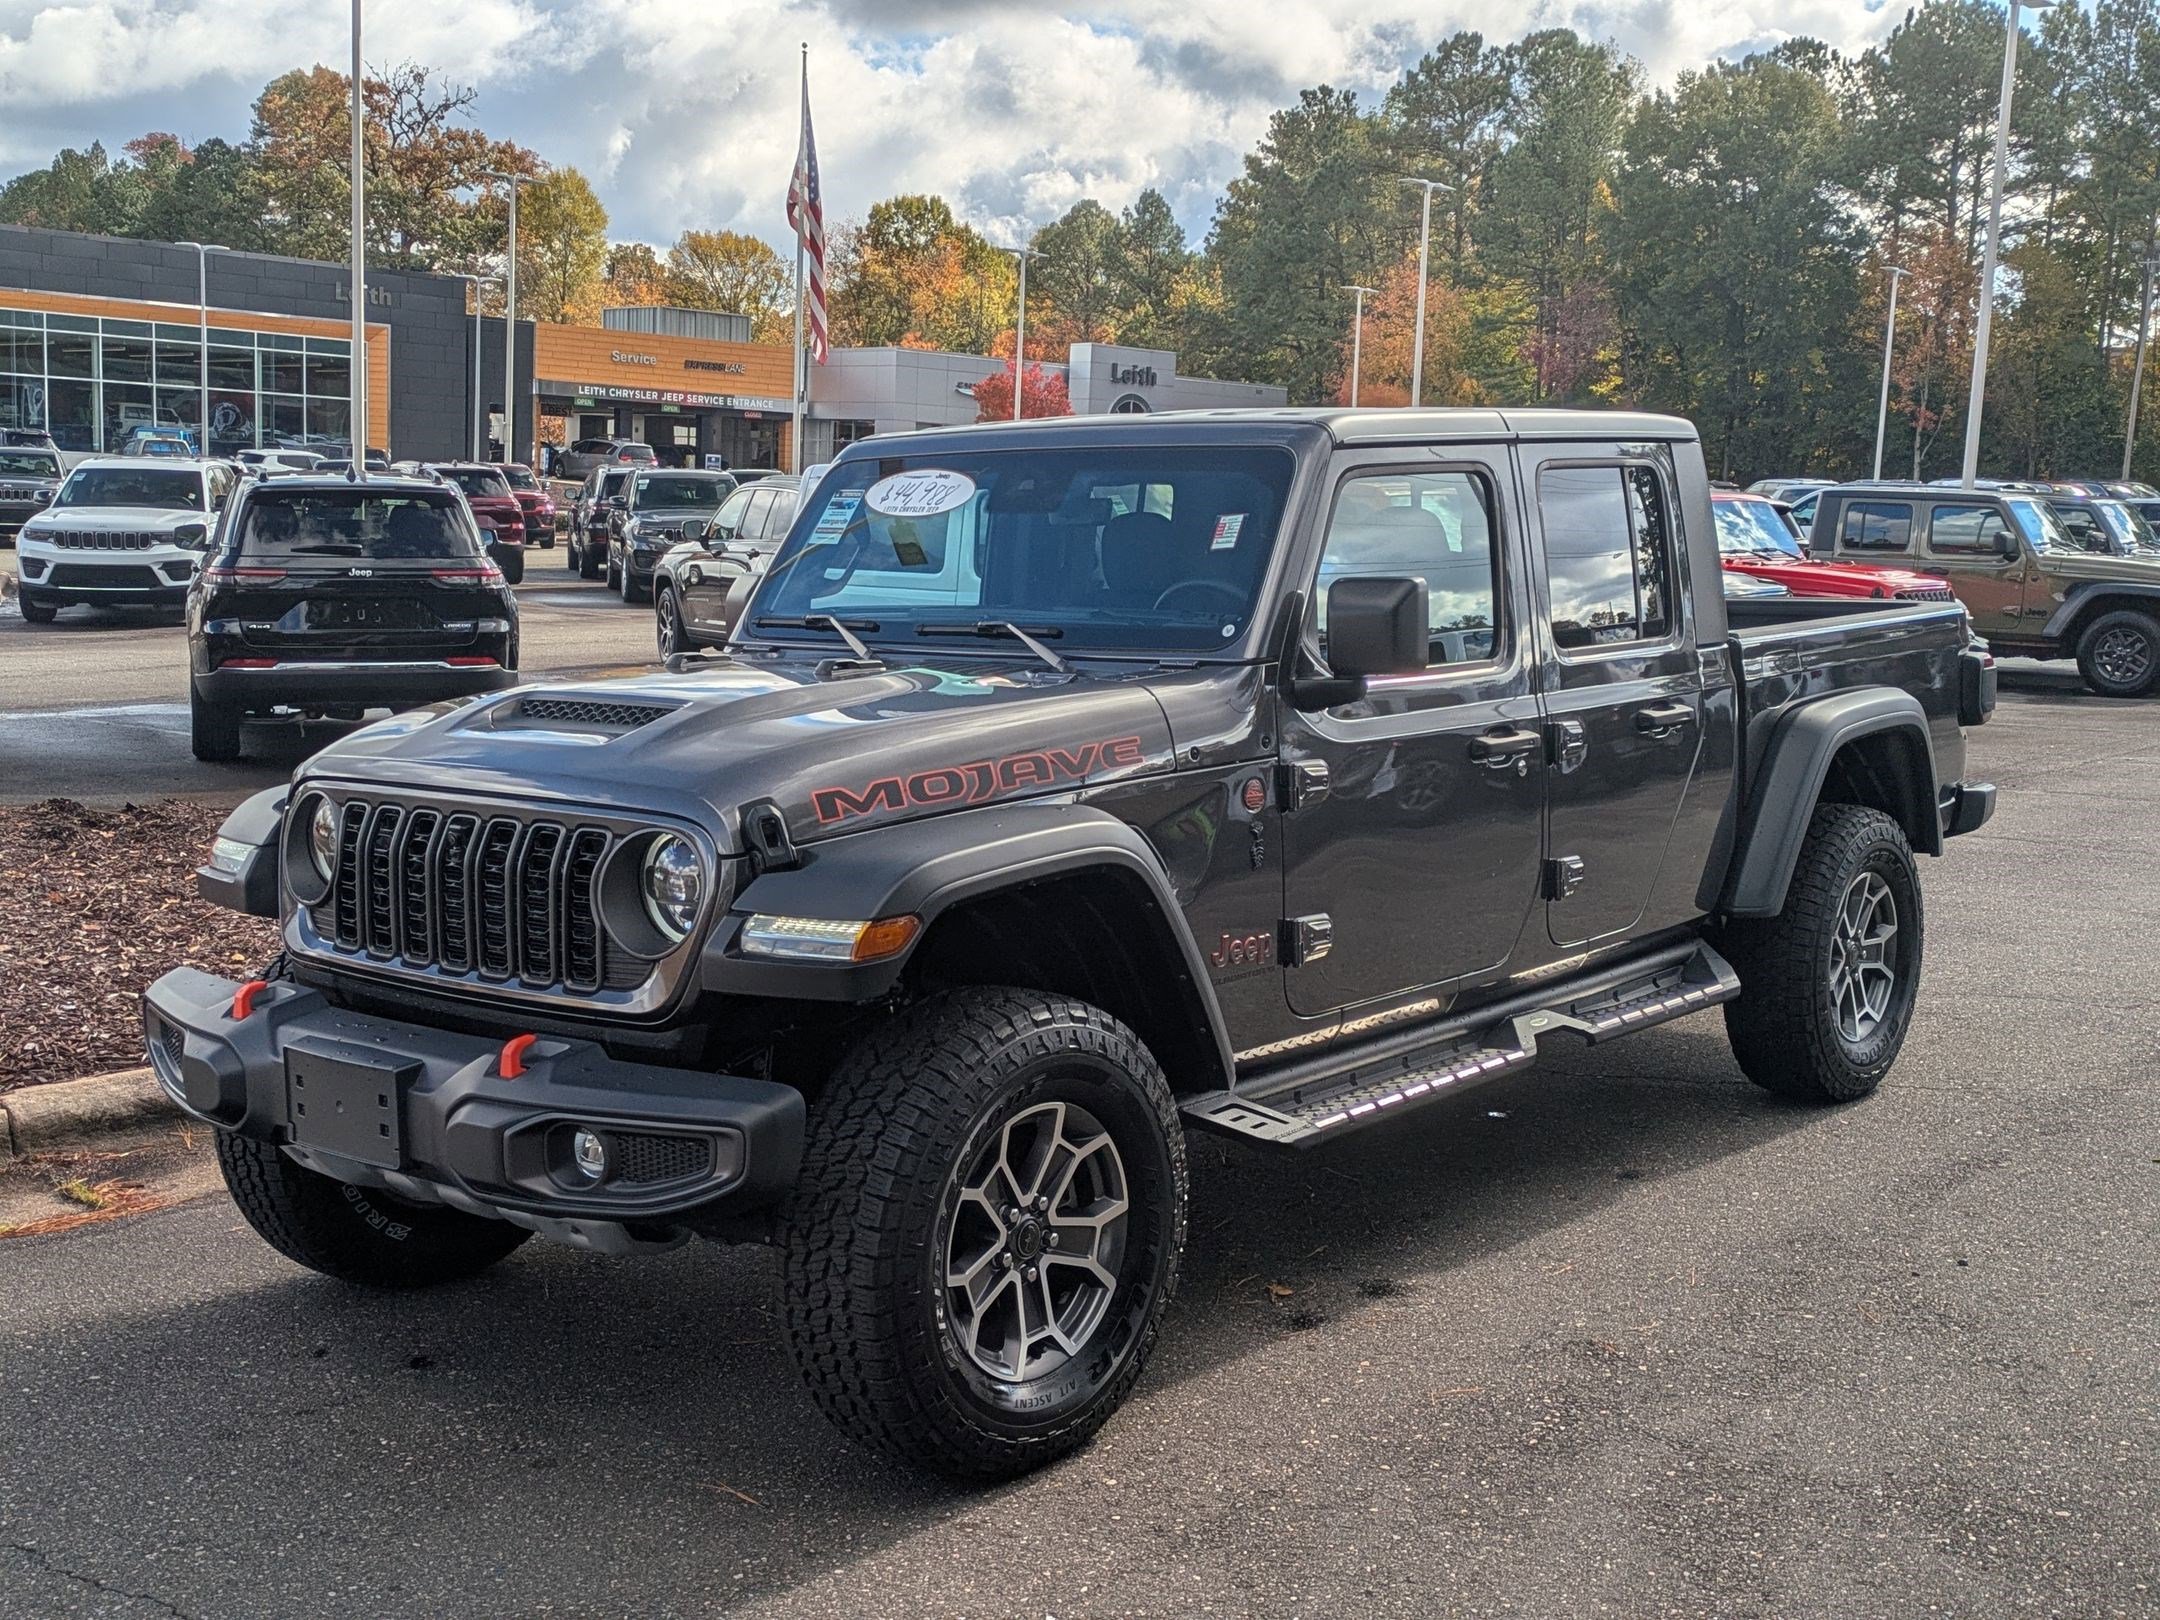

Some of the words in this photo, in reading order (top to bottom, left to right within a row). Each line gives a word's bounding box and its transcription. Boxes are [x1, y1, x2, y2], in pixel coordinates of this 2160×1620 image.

[611, 350, 657, 365] Service
[1110, 363, 1157, 387] Leith
[578, 385, 606, 396] LEITH
[608, 388, 658, 400] CHRYSLER
[661, 391, 684, 402] JEEP
[686, 394, 725, 405] SERVICE
[726, 397, 774, 409] ENTRANCE
[348, 568, 373, 577] Jeep
[2024, 607, 2047, 617] Jeep
[811, 736, 1144, 823] MOJAVE
[1211, 933, 1272, 967] Jeep
[1060, 1378, 1076, 1396] A/T
[1015, 1392, 1052, 1408] ASCENT
